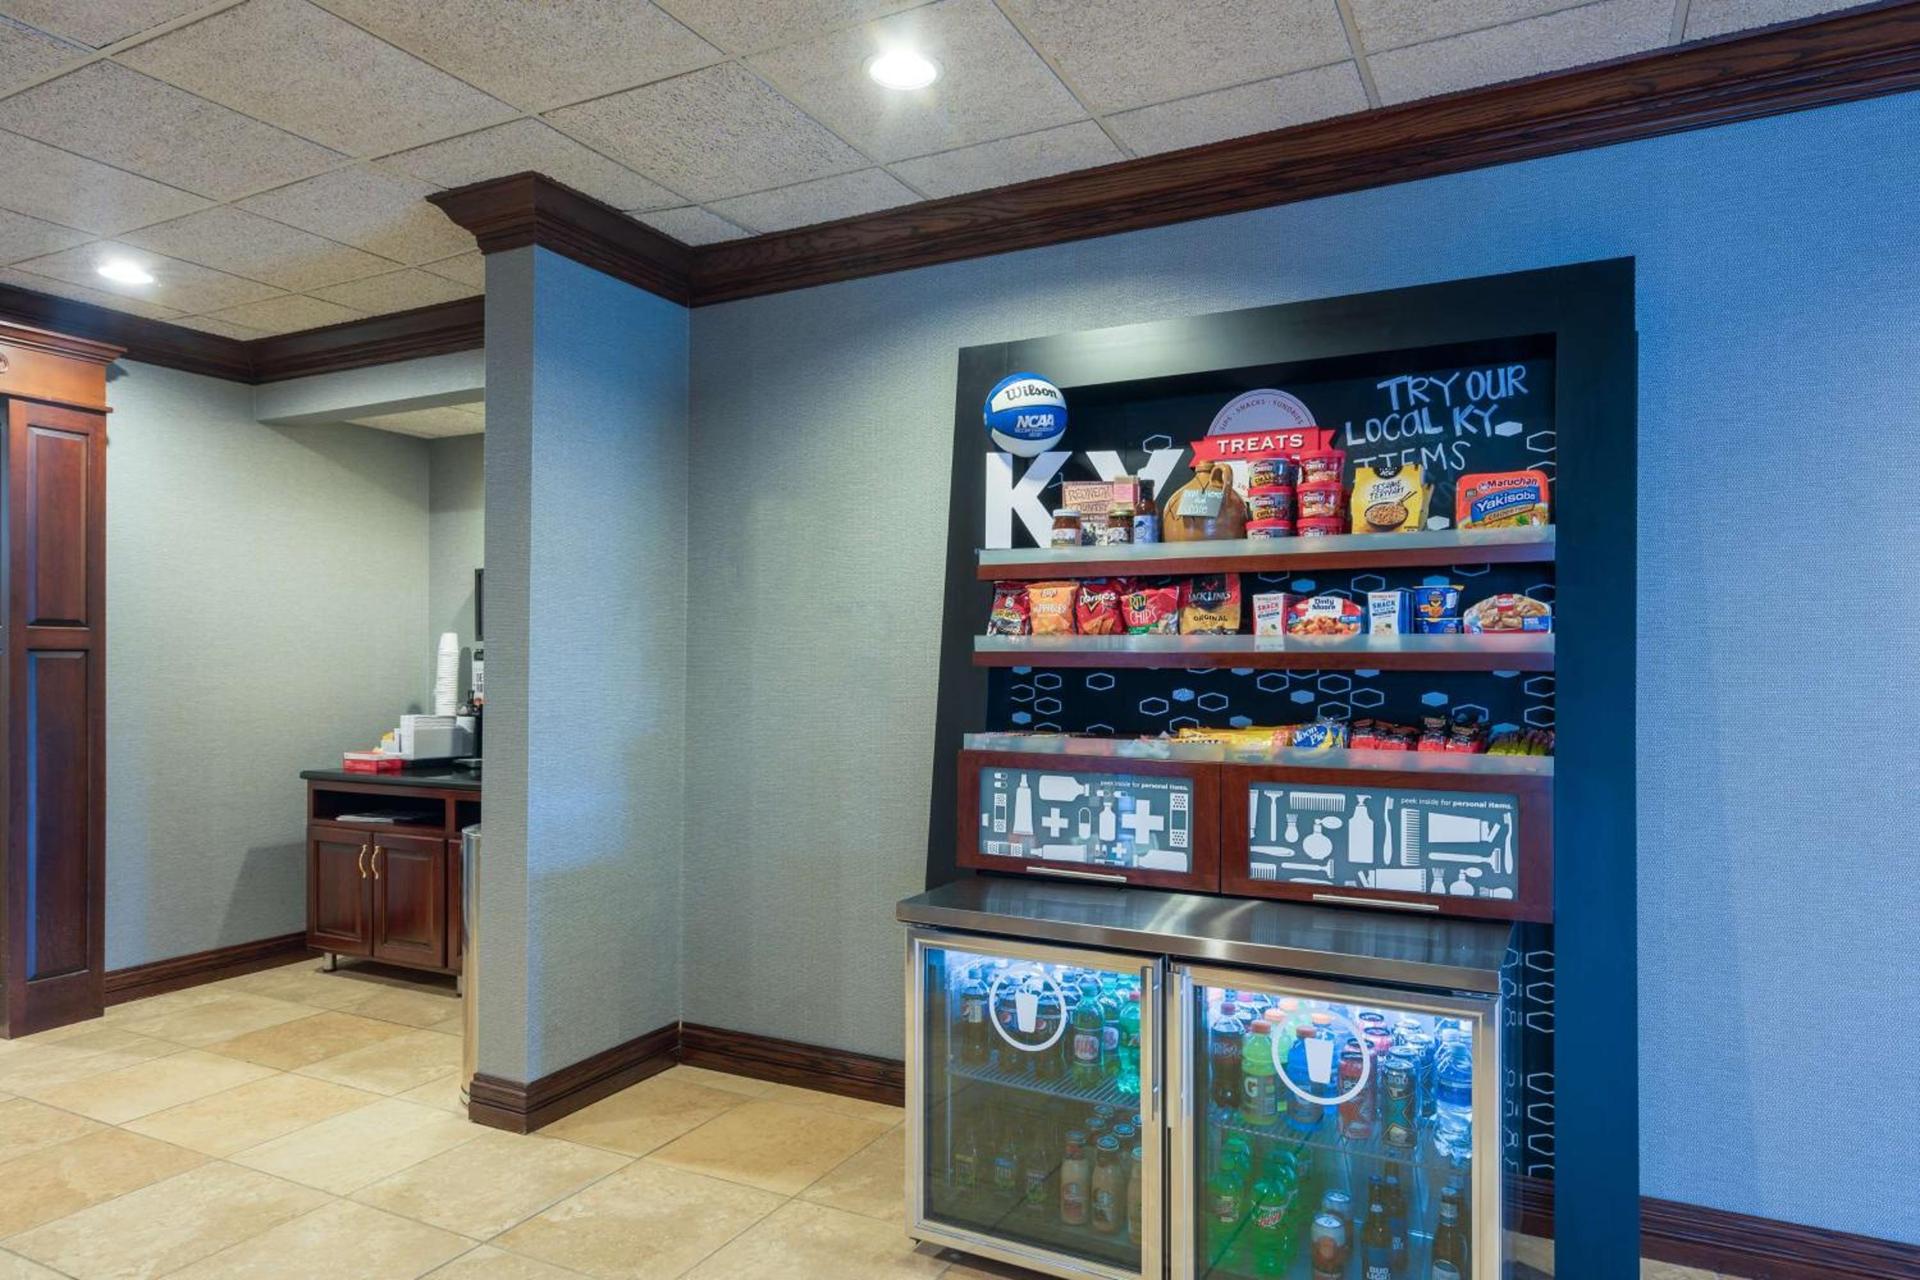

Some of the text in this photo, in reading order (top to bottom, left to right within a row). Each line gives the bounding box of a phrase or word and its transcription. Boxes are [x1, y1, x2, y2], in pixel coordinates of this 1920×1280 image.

[1005, 384, 1058, 401] Wilson
[1376, 365, 1529, 411] TRY OUR
[1015, 413, 1055, 429] NCAA
[1345, 404, 1498, 447] LOCAL KY
[1216, 433, 1304, 454] TREATS
[1353, 440, 1471, 471] ITEMS
[1487, 477, 1538, 488] Maruchan
[986, 449, 1184, 549] KY
[1476, 491, 1536, 512] Yakisoba
[1130, 606, 1158, 625] CHIPS
[1193, 614, 1228, 622] ORIGINAL
[1440, 798, 1451, 806] for
[1452, 800, 1487, 809] personal
[1244, 1076, 1258, 1098] G
